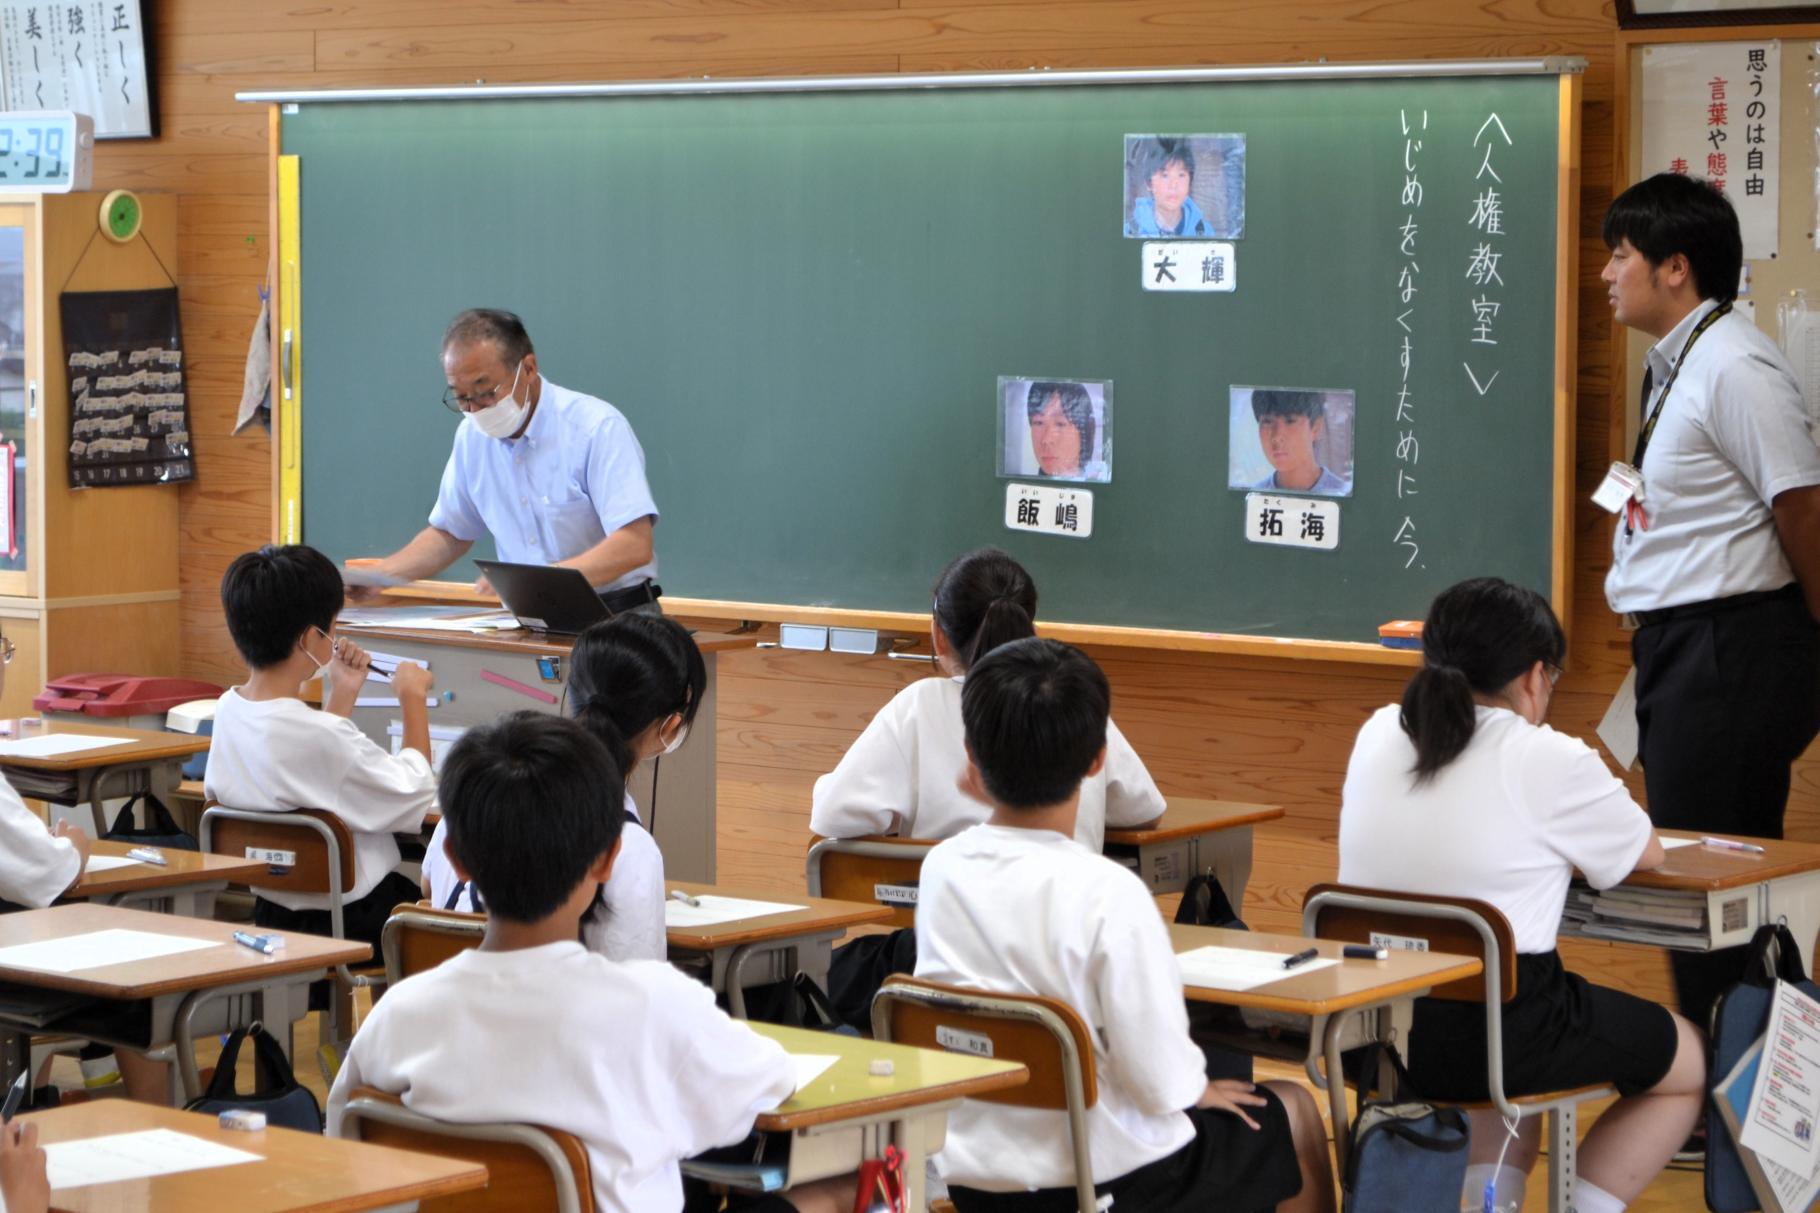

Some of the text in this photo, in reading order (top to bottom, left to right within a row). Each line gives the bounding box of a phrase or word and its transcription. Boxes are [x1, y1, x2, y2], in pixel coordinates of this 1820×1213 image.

[24, 7, 44, 109] 美しく
[67, 5, 85, 69] 強く
[111, 4, 130, 105] 正しく
[1745, 48, 1768, 197] 思うのは自由
[1153, 255, 1225, 284] 大輝
[1017, 498, 1078, 532] 飯嶋
[1259, 507, 1325, 542] 拓海
